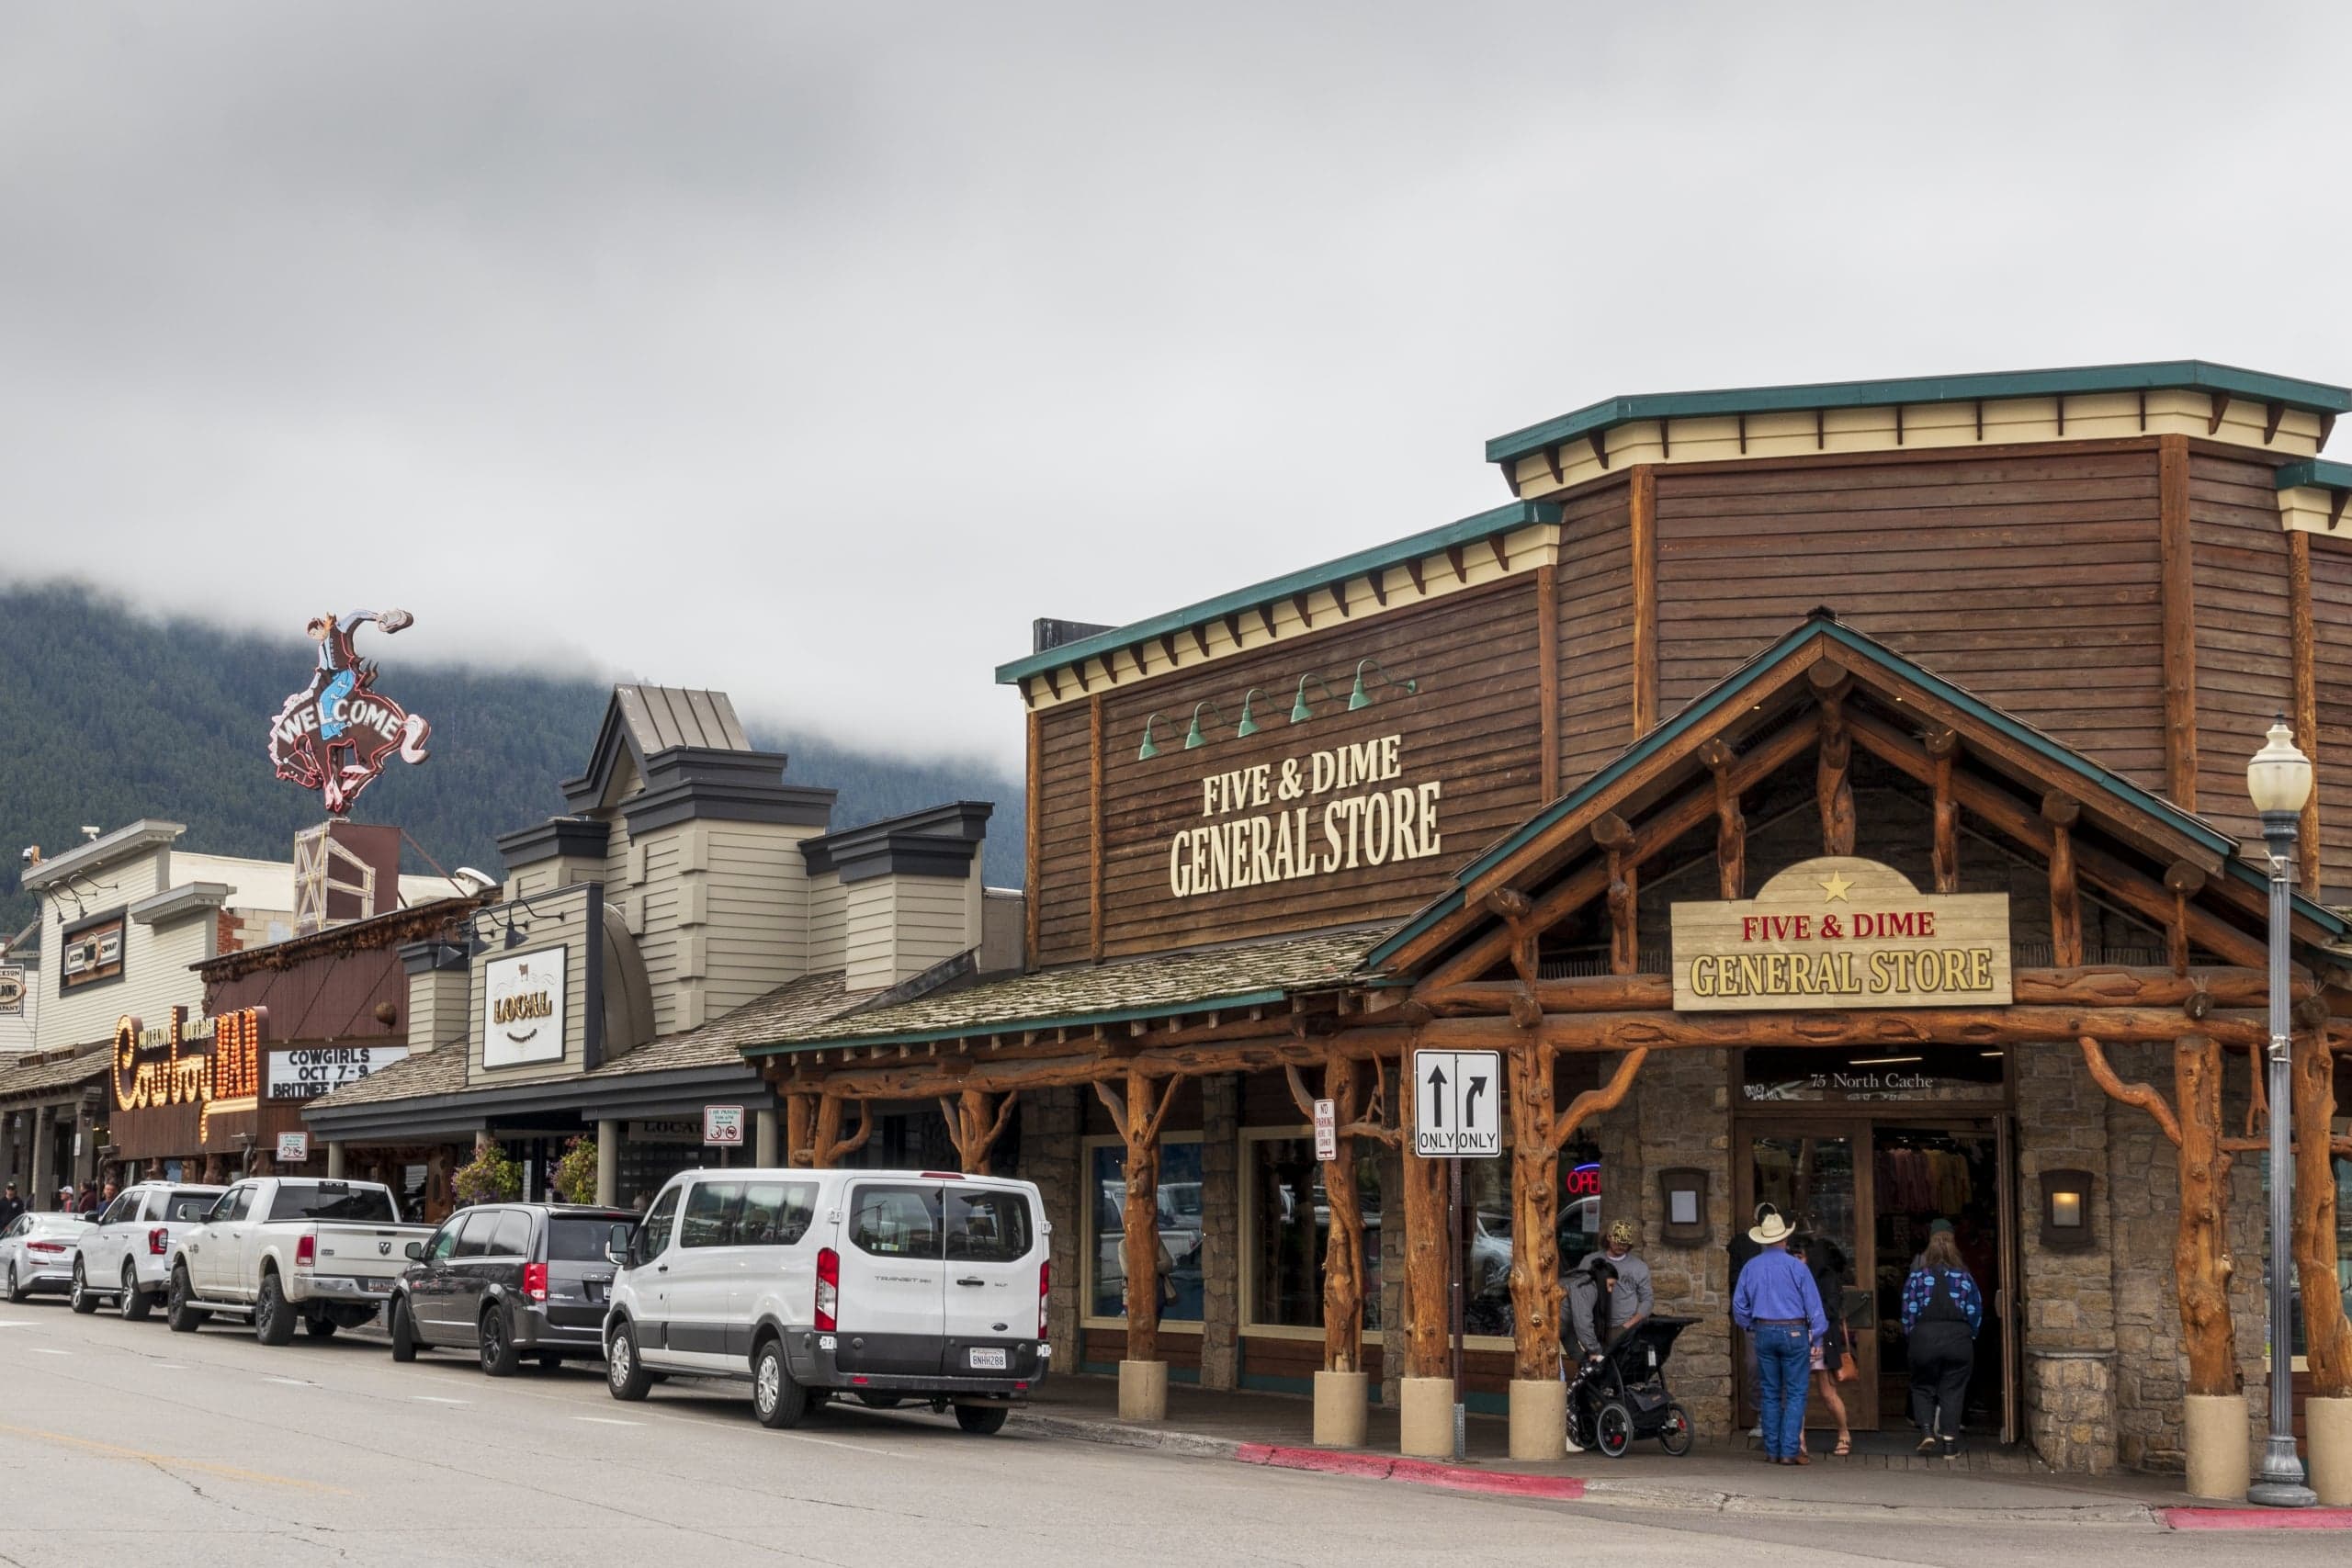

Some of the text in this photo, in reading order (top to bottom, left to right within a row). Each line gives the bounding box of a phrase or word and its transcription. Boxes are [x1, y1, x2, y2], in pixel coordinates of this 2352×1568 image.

[276, 699, 402, 743] WELCOME
[1202, 734, 1401, 817] FIVE & DIME
[1170, 781, 1441, 897] GENERAL STORE
[1742, 911, 1936, 942] FIVE & DIME
[1690, 949, 1994, 997] GENERAL STORE
[493, 990, 553, 1024] LOCAL
[288, 1048, 370, 1066] COWGIRLS
[113, 1006, 258, 1144] Cowboy BAR
[299, 1066, 329, 1080] OCT
[1810, 1073, 1934, 1089] 75 North Cache
[273, 1082, 330, 1098] BRITNEE
[1320, 1103, 1329, 1114] NO
[1419, 1133, 1454, 1148] ONLY
[1459, 1133, 1496, 1148] ONLY
[1566, 1171, 1600, 1194] OPE
